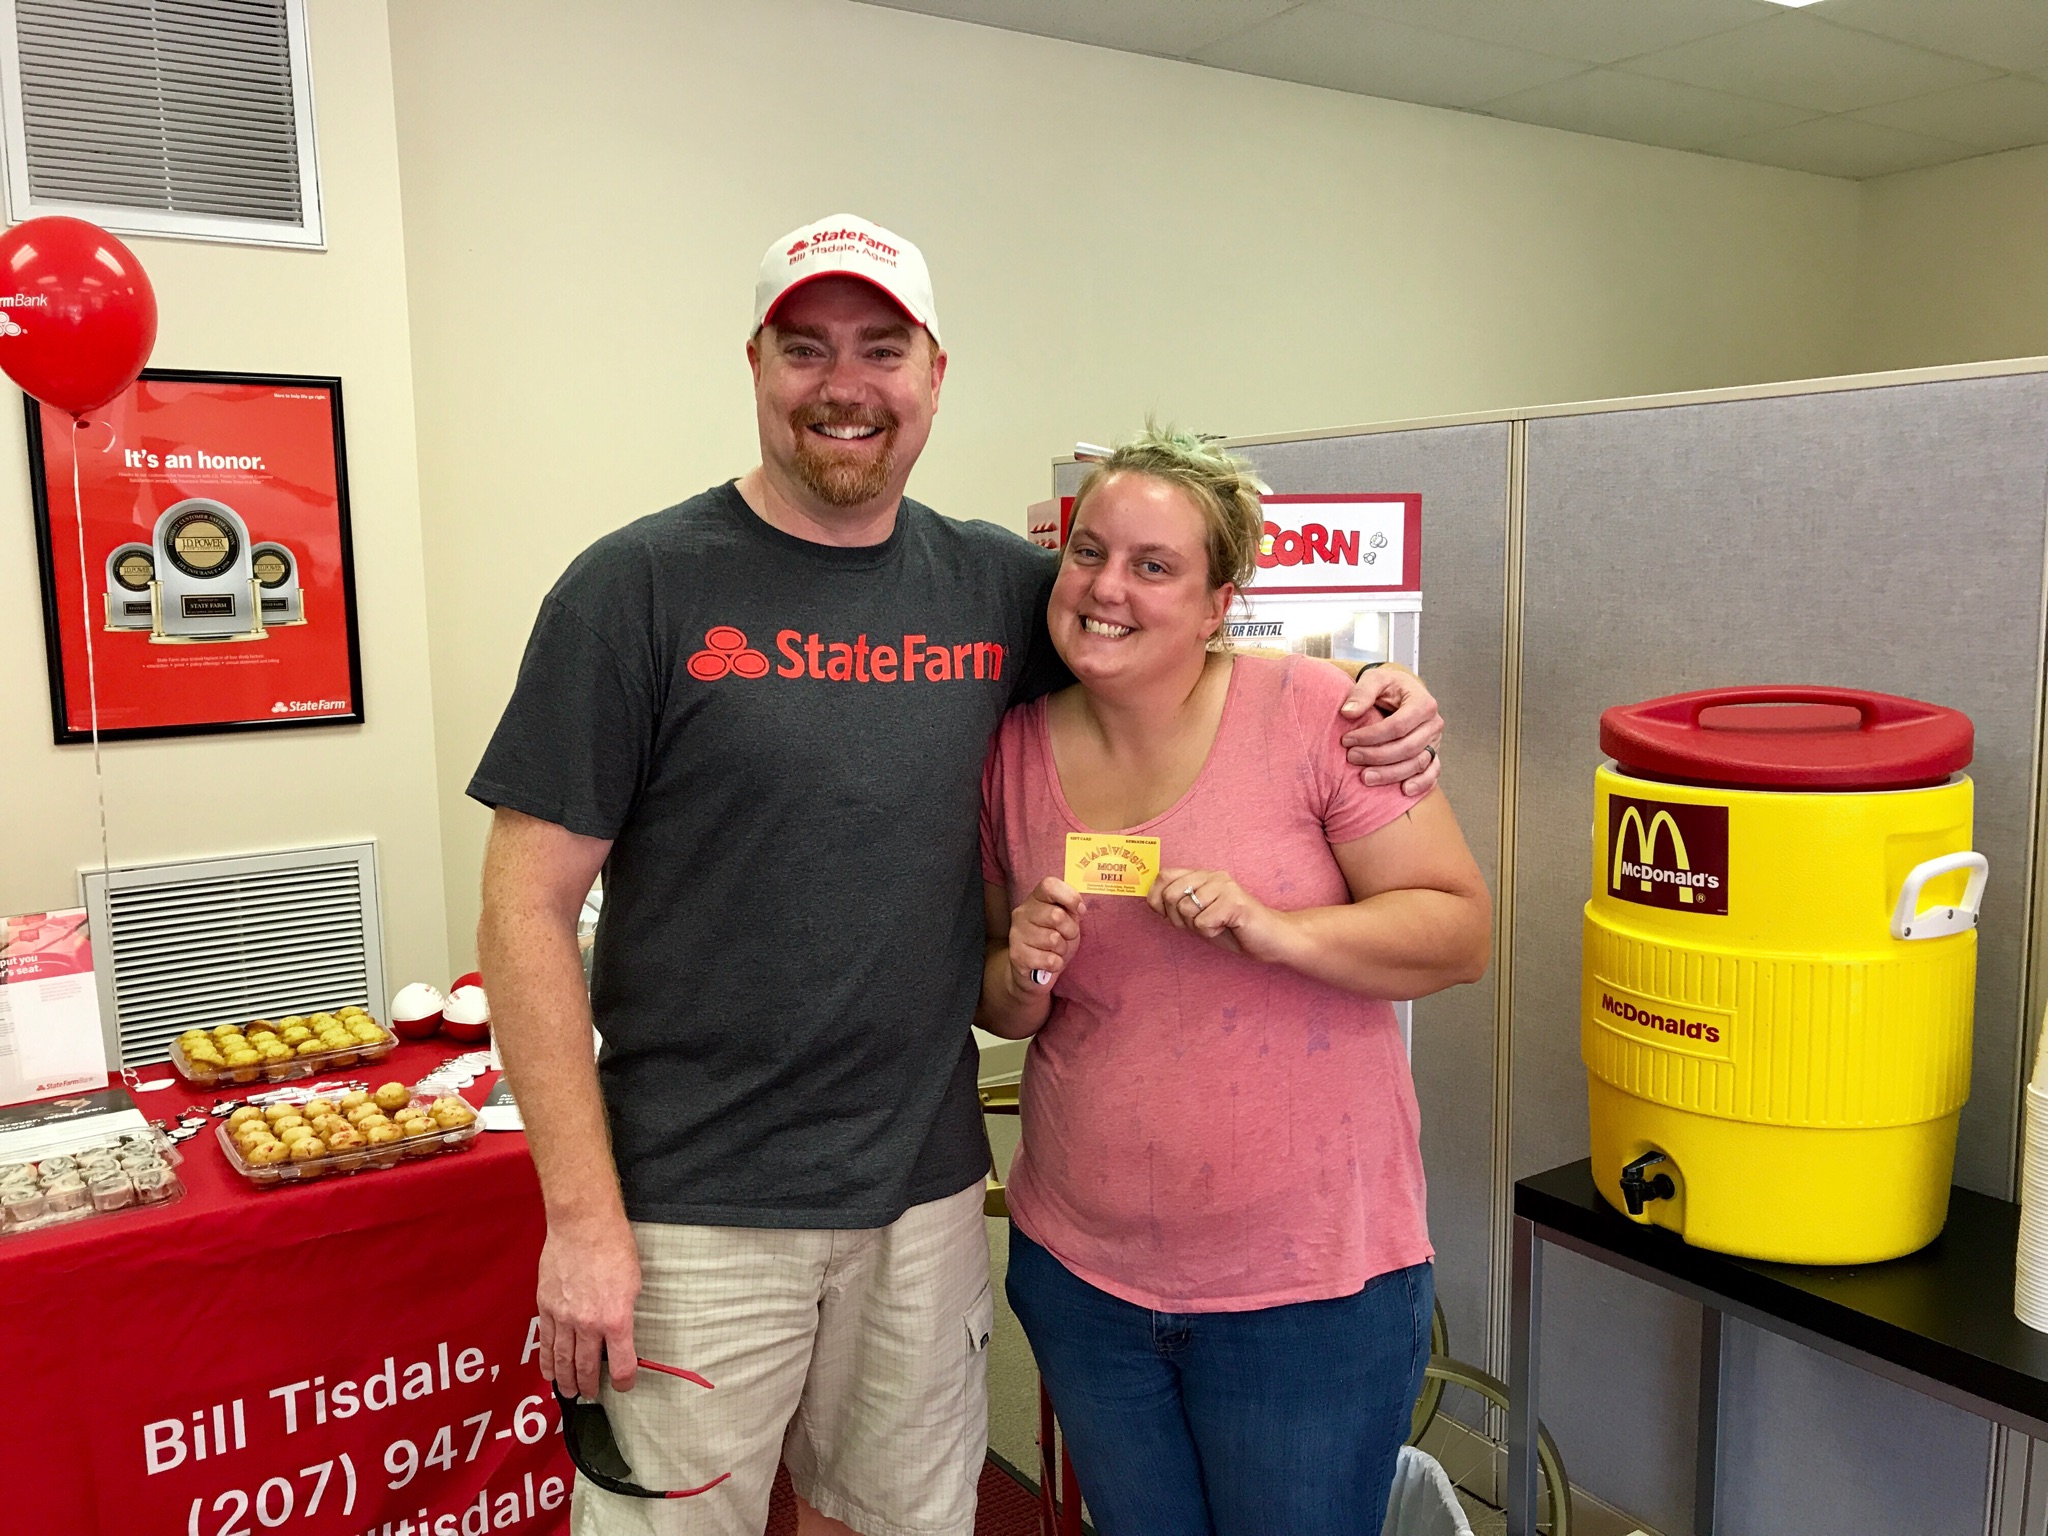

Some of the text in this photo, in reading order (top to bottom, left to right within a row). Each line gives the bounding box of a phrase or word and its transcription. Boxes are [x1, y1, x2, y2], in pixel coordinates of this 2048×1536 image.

[789, 243, 898, 268] Bill Tisdale, Agent
[124, 449, 266, 470] It's an honor.
[1246, 625, 1282, 636] RENTAL
[1079, 846, 1147, 872] HARVEST
[1097, 863, 1127, 872] MOON
[1101, 873, 1123, 882] DELI
[1622, 861, 1719, 889] McDonald's
[16, 964, 42, 975] seat.
[19, 955, 38, 964] you
[1602, 993, 1720, 1043] McDonald's
[143, 1398, 247, 1475] Bill
[269, 1341, 499, 1435] Tisdale,
[188, 1453, 357, 1536] (207)
